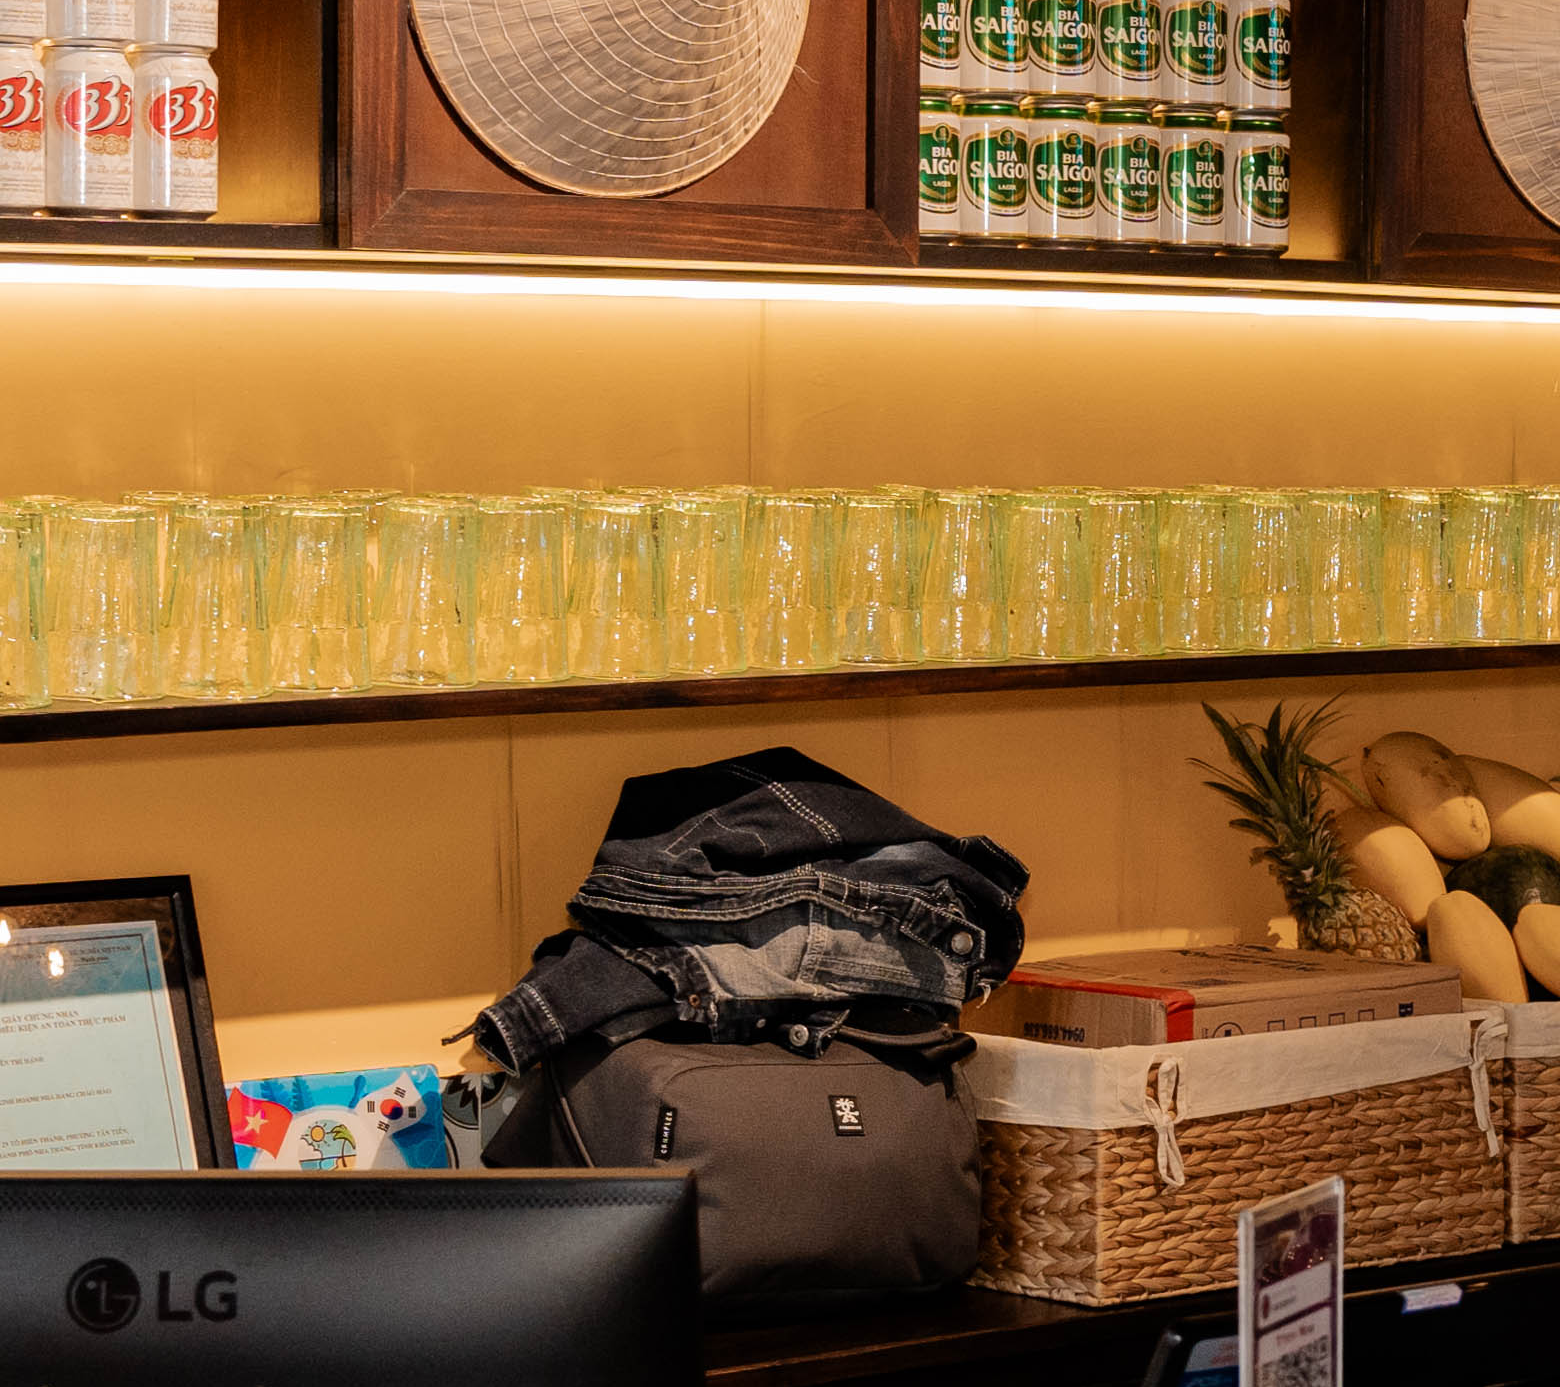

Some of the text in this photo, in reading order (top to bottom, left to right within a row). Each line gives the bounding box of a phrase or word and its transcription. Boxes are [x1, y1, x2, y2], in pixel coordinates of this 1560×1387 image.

[937, 2, 955, 14] BIA
[1001, 5, 1020, 18] BIA
[1058, 9, 1080, 21] BIA
[1130, 15, 1149, 27] BIA
[920, 15, 960, 31] AIGO
[974, 18, 1028, 34] SAIGO
[1198, 20, 1218, 33] BIA
[1268, 27, 1285, 39] BIA
[1243, 37, 1290, 54] SAIGO
[74, 75, 131, 131] 333
[161, 80, 216, 136] 333
[932, 147, 952, 158] BIA
[996, 150, 1018, 162] BIA
[1063, 153, 1084, 165] BIA
[920, 159, 959, 175] AIGO
[1130, 157, 1151, 169] BIA
[1196, 161, 1215, 173] BIA
[1267, 165, 1285, 177] BIA
[1170, 171, 1224, 189] SAIGO
[1243, 175, 1289, 193] SAIGO
[157, 1270, 239, 1322] LG
